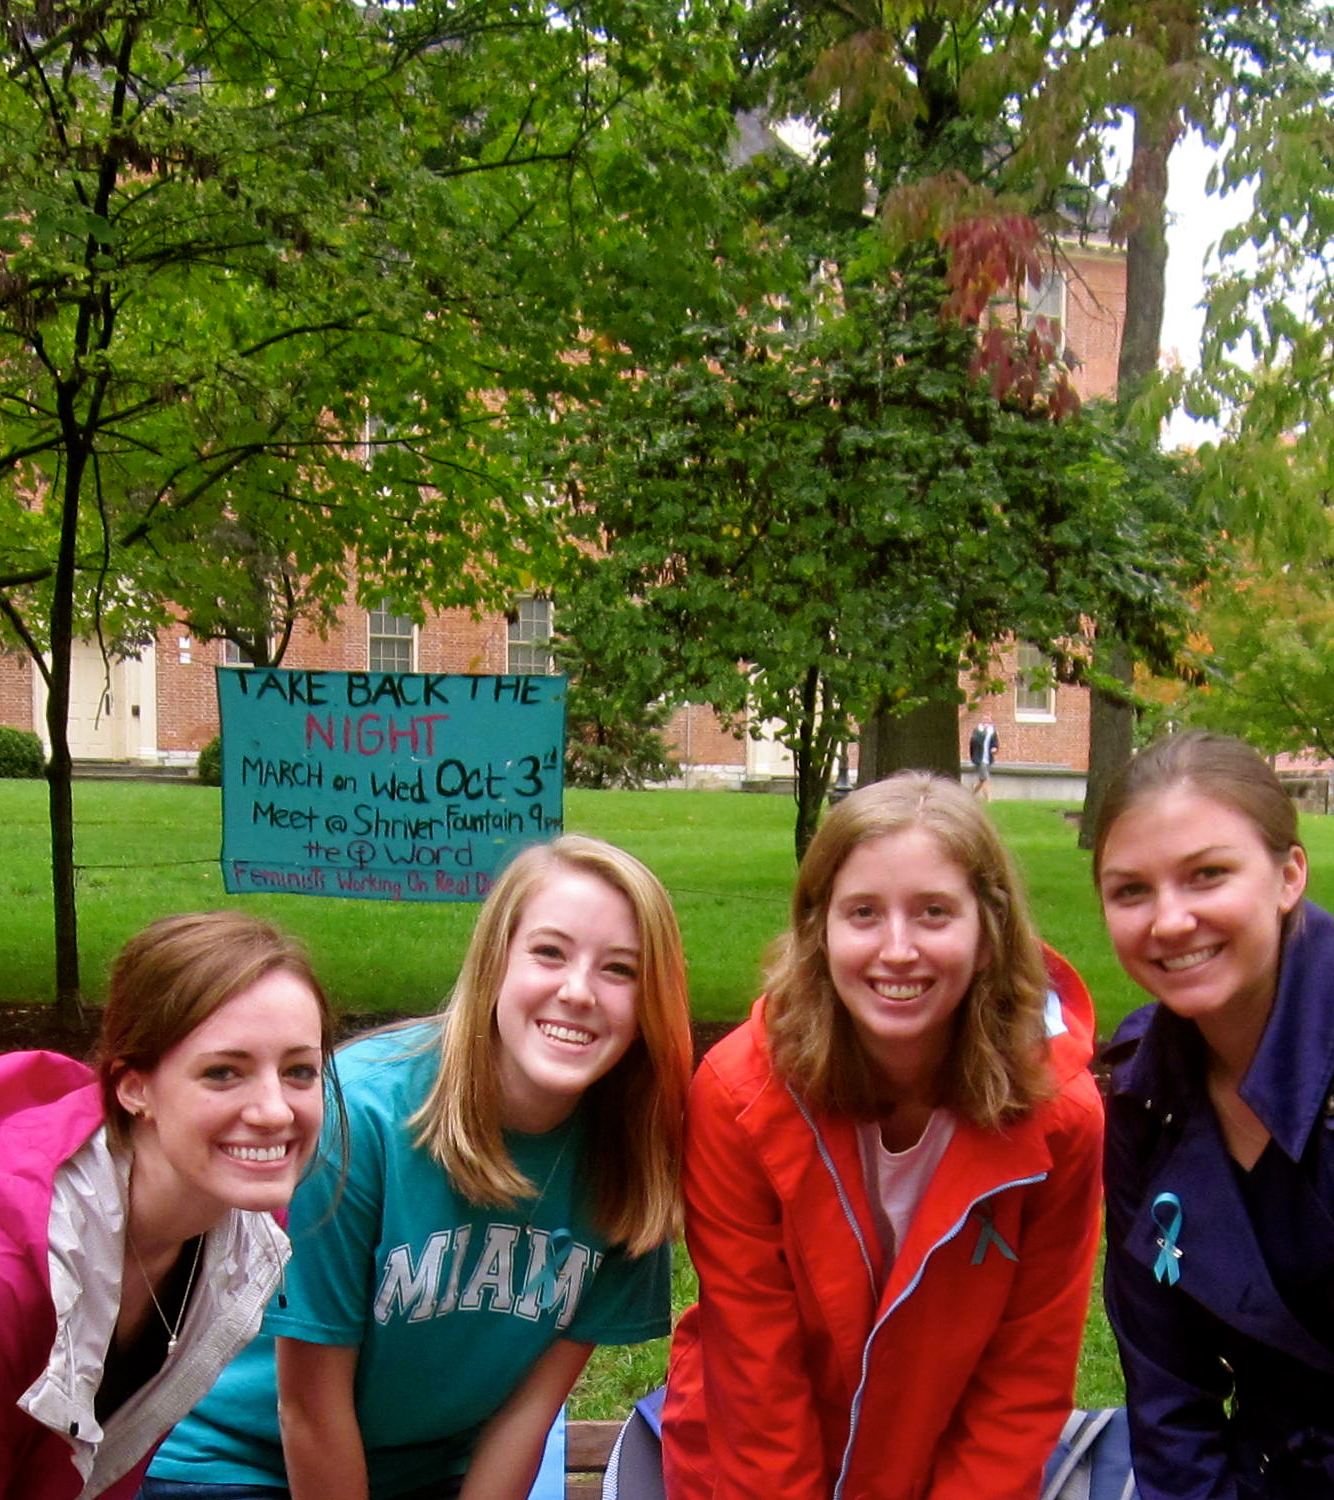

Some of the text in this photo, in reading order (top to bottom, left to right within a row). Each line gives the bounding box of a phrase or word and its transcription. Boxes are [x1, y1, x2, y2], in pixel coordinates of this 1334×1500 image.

[236, 671, 543, 707] TAKE BACK THE
[305, 711, 450, 756] NIGHT
[241, 756, 323, 788] MARCH
[333, 774, 357, 794] on
[370, 769, 428, 804] Wed
[436, 758, 508, 801] Oct
[252, 801, 320, 833] Meet
[324, 812, 349, 834] @
[353, 803, 446, 840] Shriver
[446, 803, 524, 839] Fountain
[303, 841, 341, 863] the
[336, 870, 402, 900] Working
[435, 870, 470, 896] Real
[373, 1222, 604, 1330] MIAM
